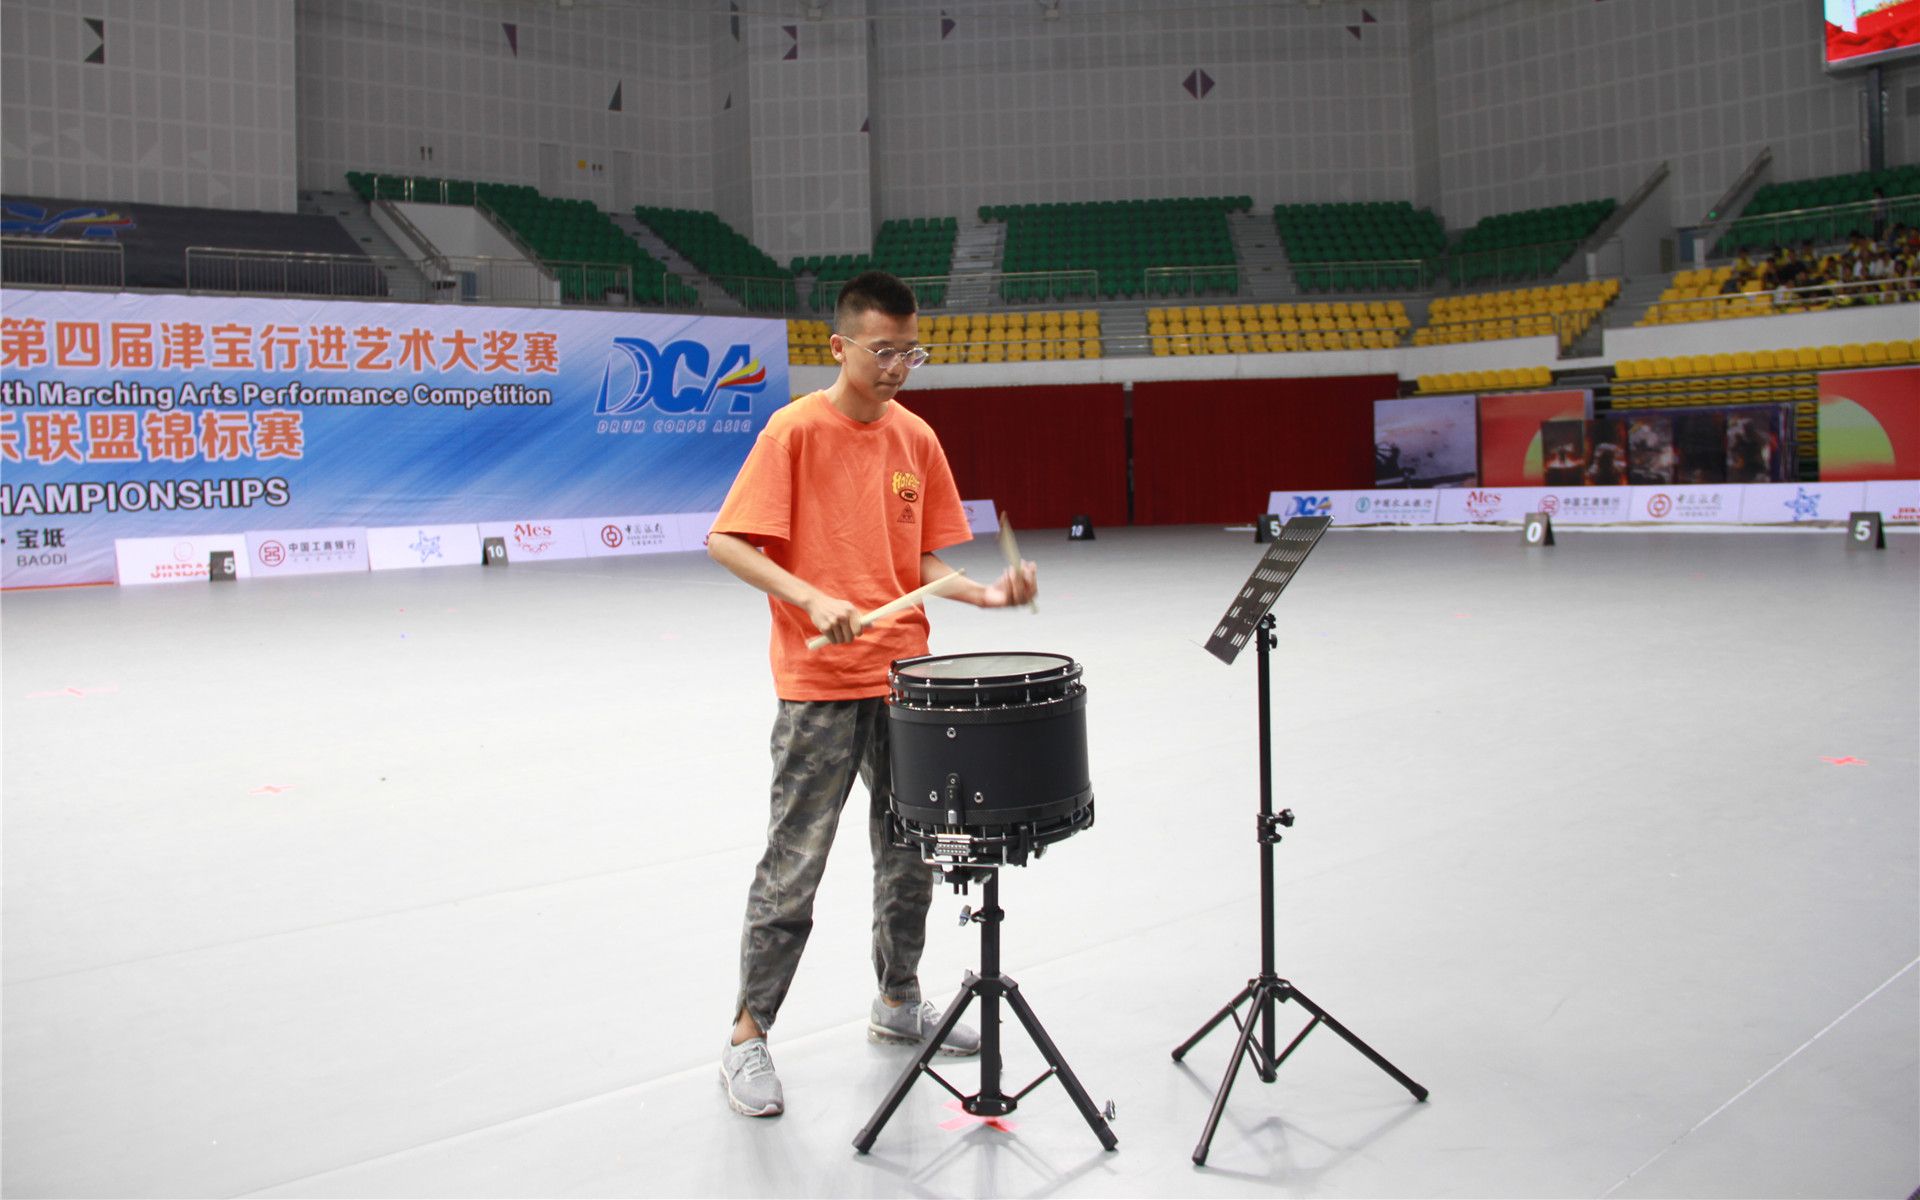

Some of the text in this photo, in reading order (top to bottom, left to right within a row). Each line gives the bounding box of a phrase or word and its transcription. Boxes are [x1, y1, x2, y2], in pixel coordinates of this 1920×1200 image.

[0, 317, 560, 374] 第四届津宝行进艺术大奖赛
[594, 336, 767, 416] DCA
[38, 380, 174, 410] Marching
[179, 382, 238, 407] Arts
[242, 382, 408, 407] Performance
[413, 384, 552, 410] Competition
[597, 419, 646, 434] DRUM
[653, 418, 706, 434] CORPS
[1071, 525, 1084, 537] 10
[1269, 521, 1281, 537] 5
[1526, 522, 1542, 543] 0
[1854, 520, 1871, 541] 5
[17, 553, 67, 567] BAODI
[487, 544, 504, 558] 10
[223, 557, 236, 575] 5
